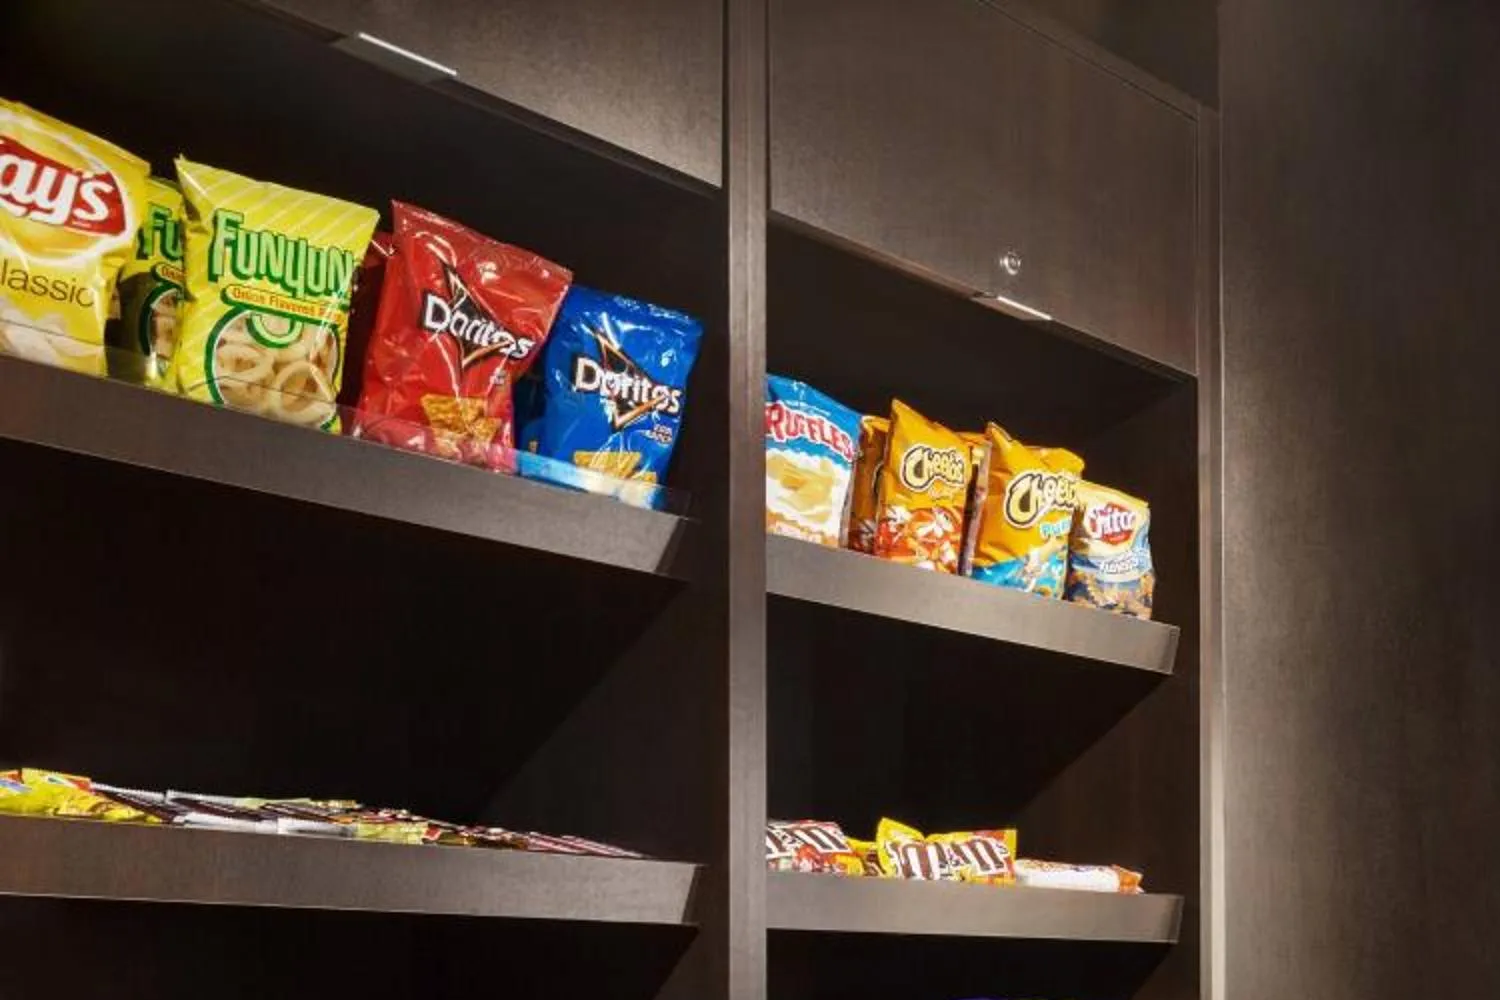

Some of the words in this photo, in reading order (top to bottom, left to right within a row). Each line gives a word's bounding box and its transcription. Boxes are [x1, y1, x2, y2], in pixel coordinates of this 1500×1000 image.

[0, 257, 95, 308] lassic
[423, 293, 537, 359] Doritos
[573, 354, 684, 414] Doritos
